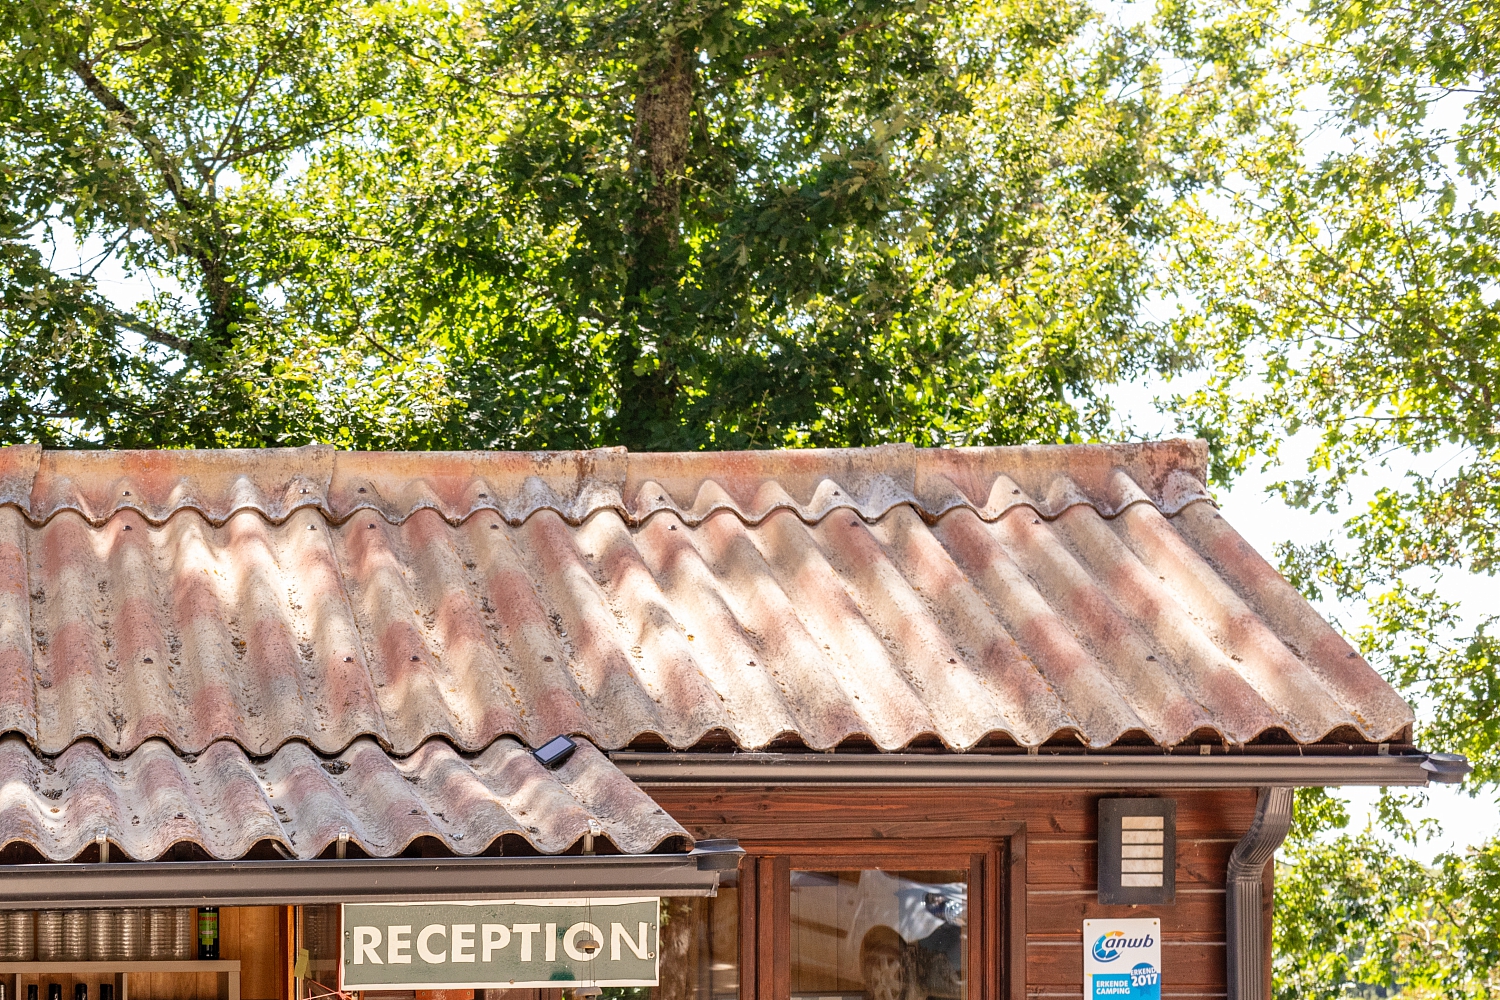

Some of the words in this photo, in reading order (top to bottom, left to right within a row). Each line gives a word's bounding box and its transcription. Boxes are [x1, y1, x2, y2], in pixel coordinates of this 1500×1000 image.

[353, 921, 649, 965] RECEPTION
[1105, 934, 1154, 948] anwb
[1096, 980, 1129, 988] ERKENDE
[1132, 973, 1158, 988] 2017
[1096, 987, 1131, 995] CAMPING
